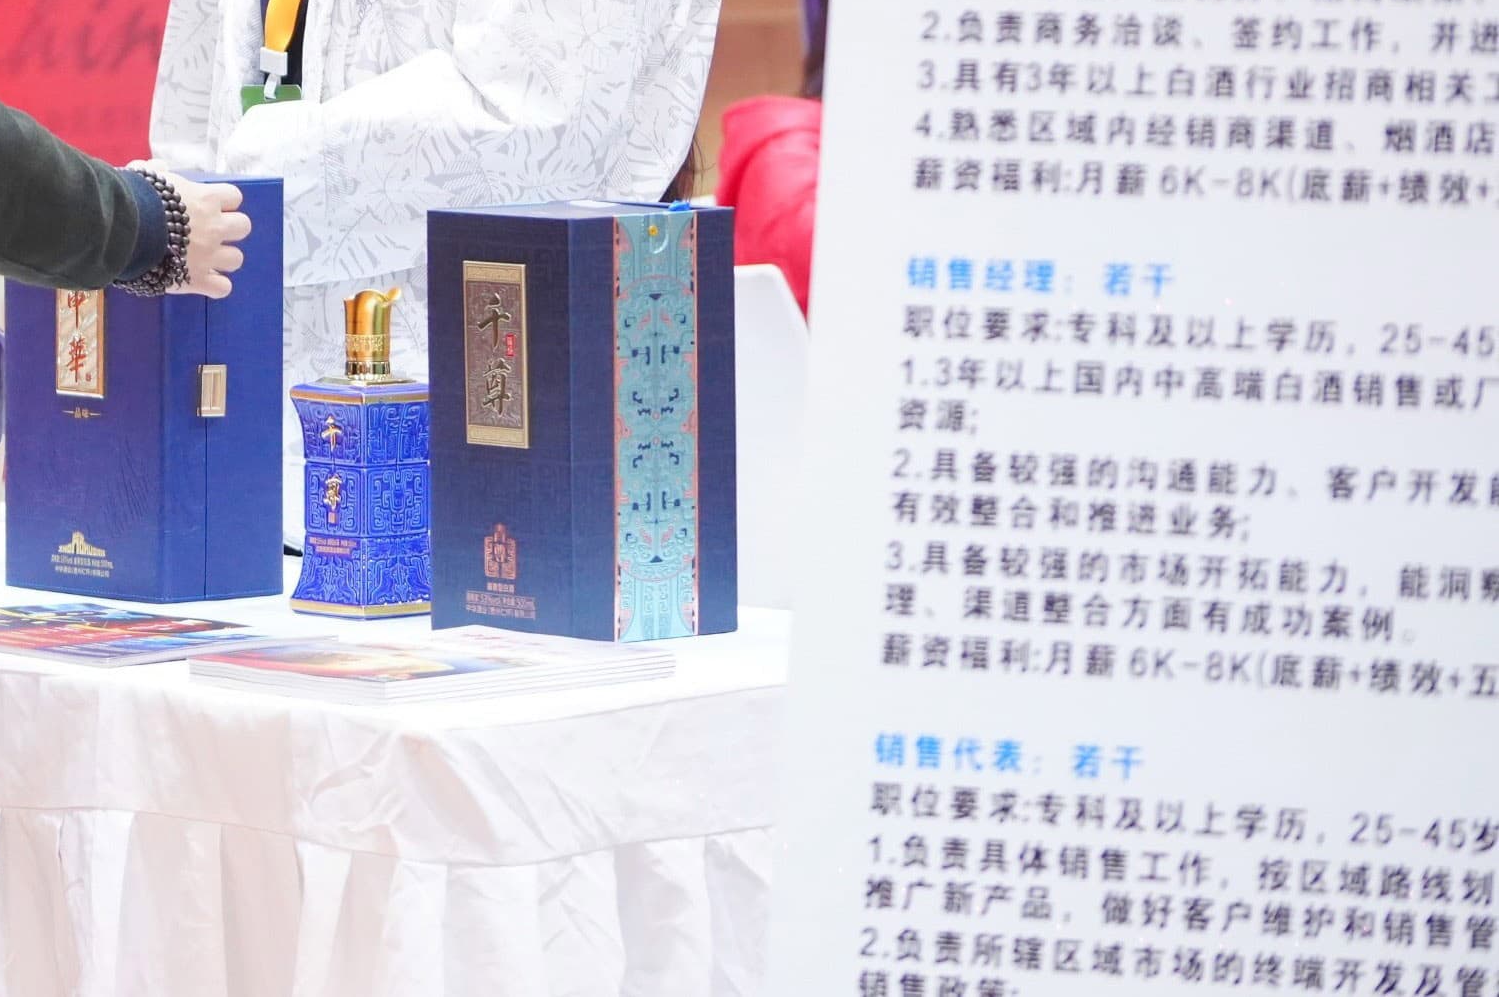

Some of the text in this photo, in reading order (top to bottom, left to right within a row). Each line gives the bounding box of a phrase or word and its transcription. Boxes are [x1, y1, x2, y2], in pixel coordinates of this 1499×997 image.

[905, 255, 1174, 300] 销售经理：若干
[898, 398, 978, 435] 资源;
[892, 489, 1250, 542] 有效整合和推进业务;
[873, 732, 1143, 781] 销售代表：若干
